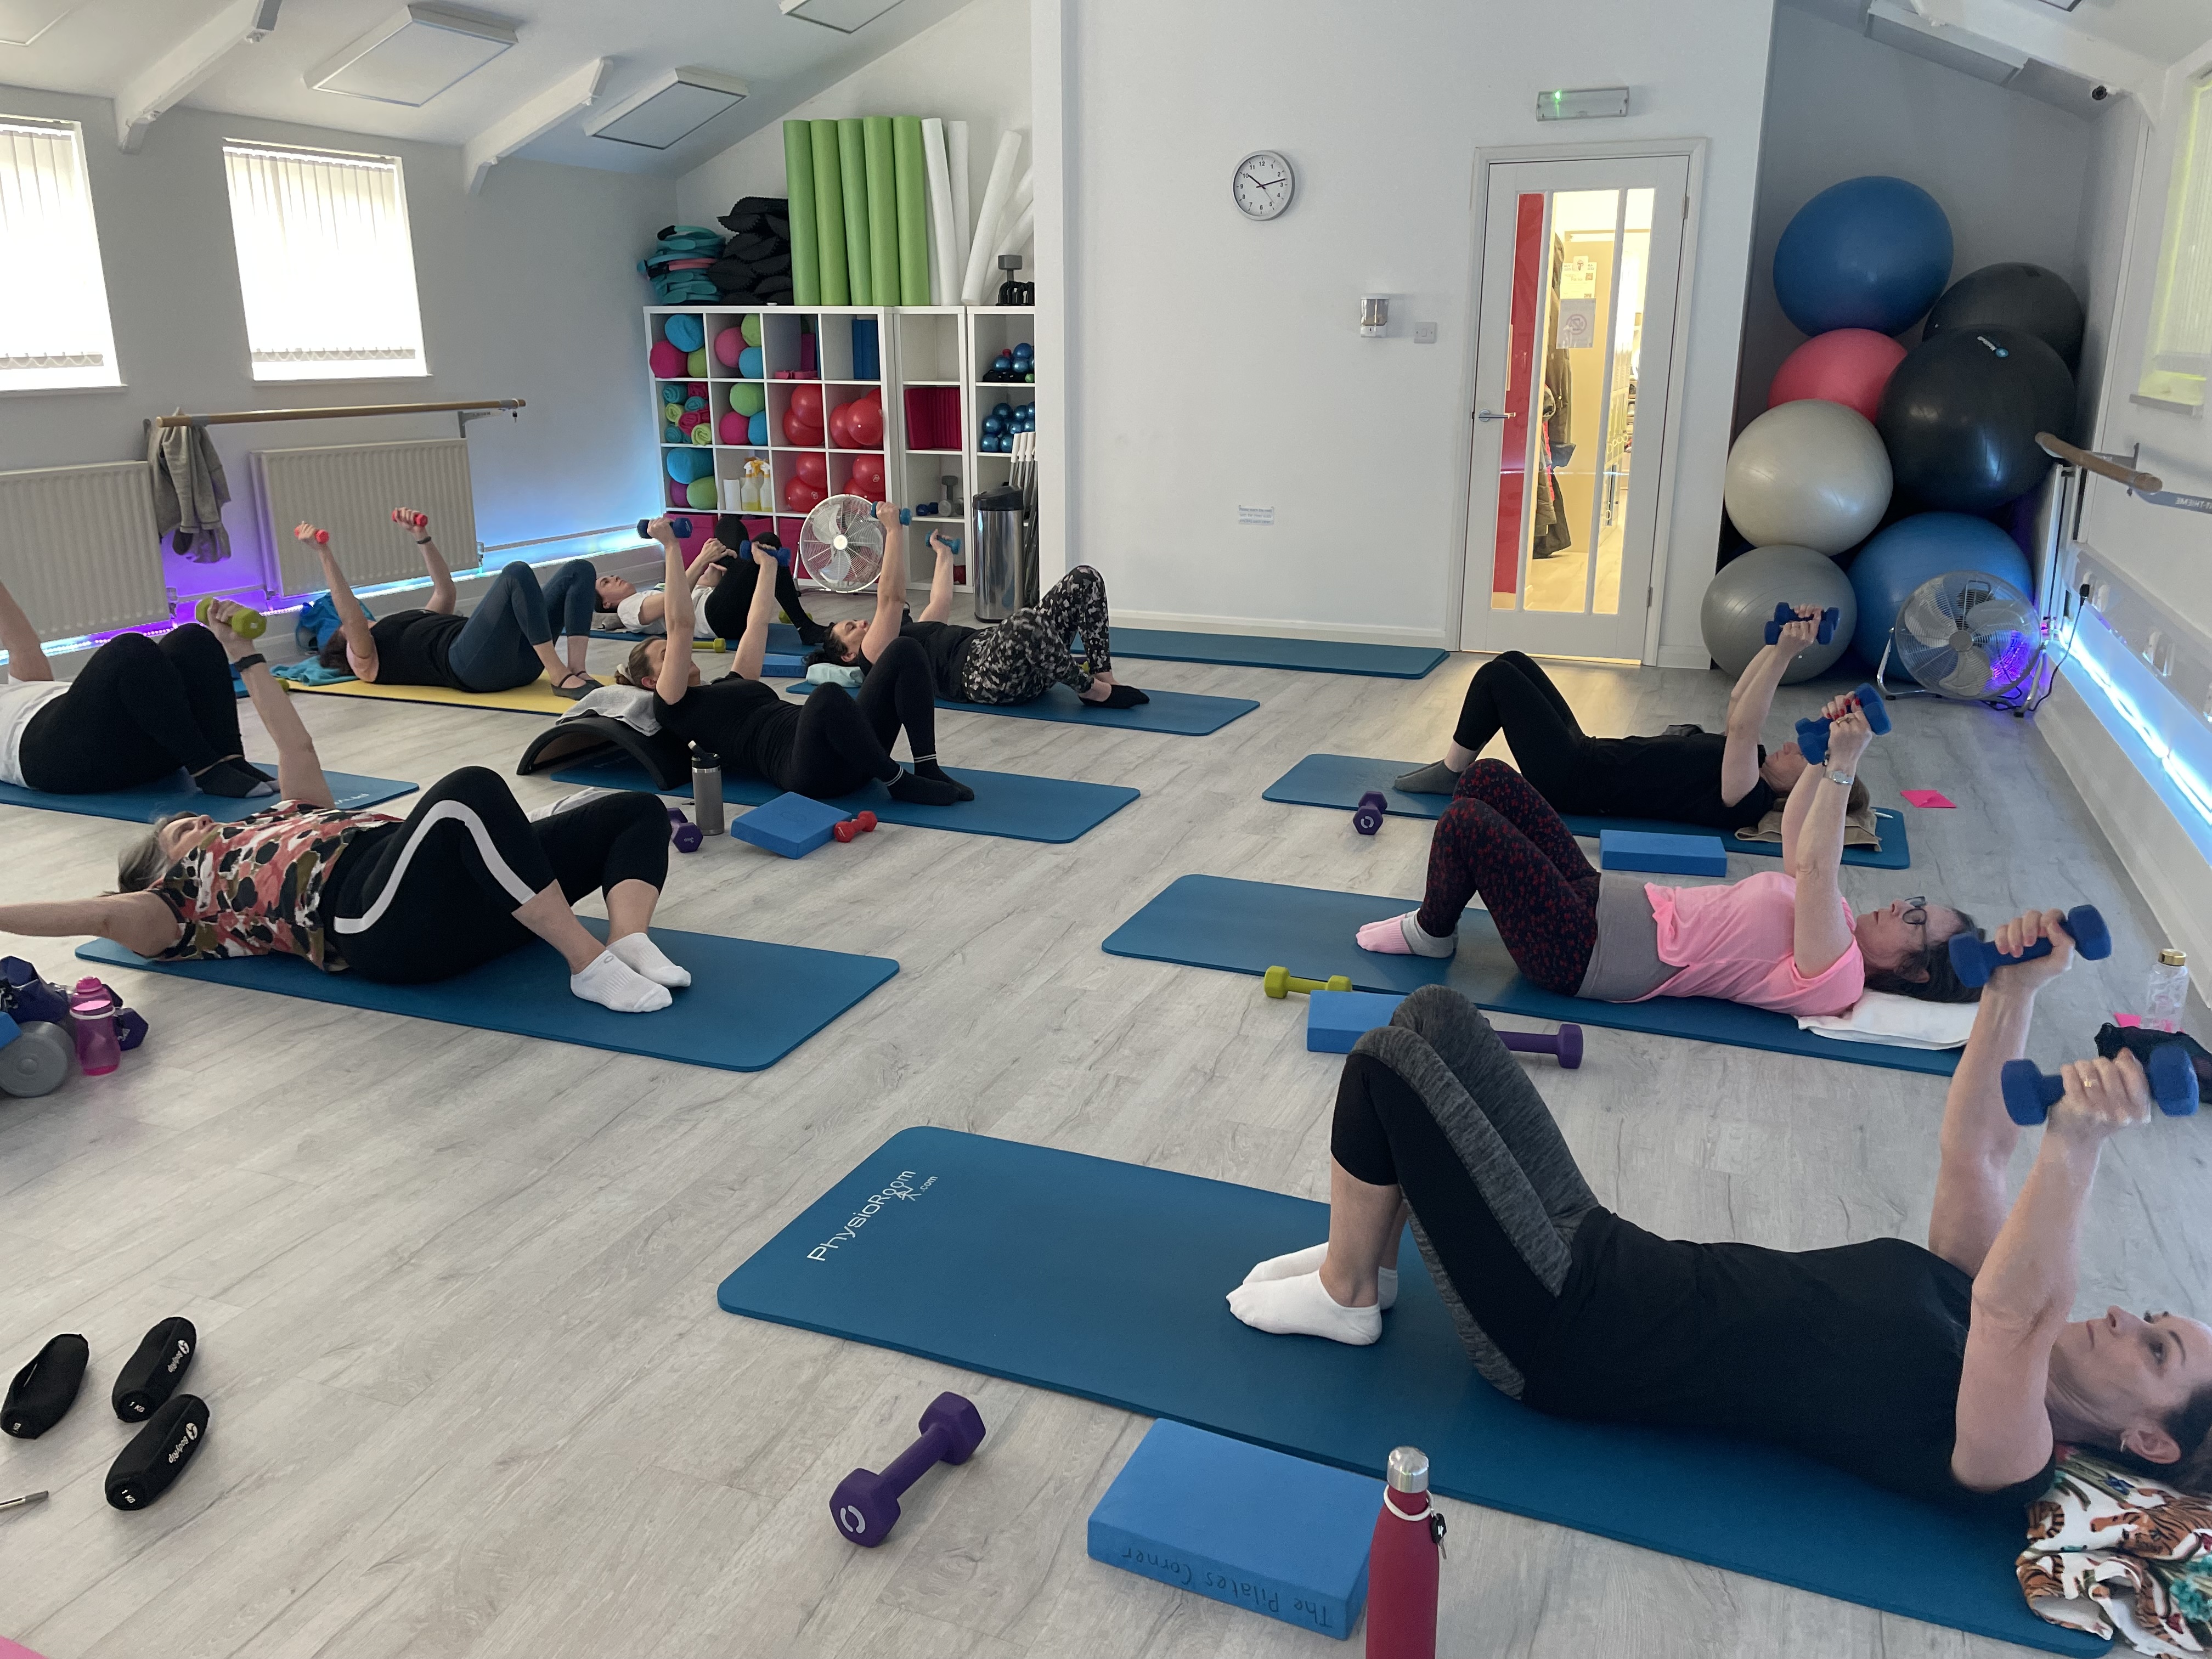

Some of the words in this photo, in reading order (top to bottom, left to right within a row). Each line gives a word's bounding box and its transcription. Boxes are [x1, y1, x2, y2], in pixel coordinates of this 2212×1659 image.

[919, 1176, 938, 1192] .com
[807, 1171, 916, 1261] PhysioRoom
[1121, 1547, 1192, 1585] Corner
[1206, 1570, 1279, 1613] Pilates
[1293, 1596, 1333, 1629] The
